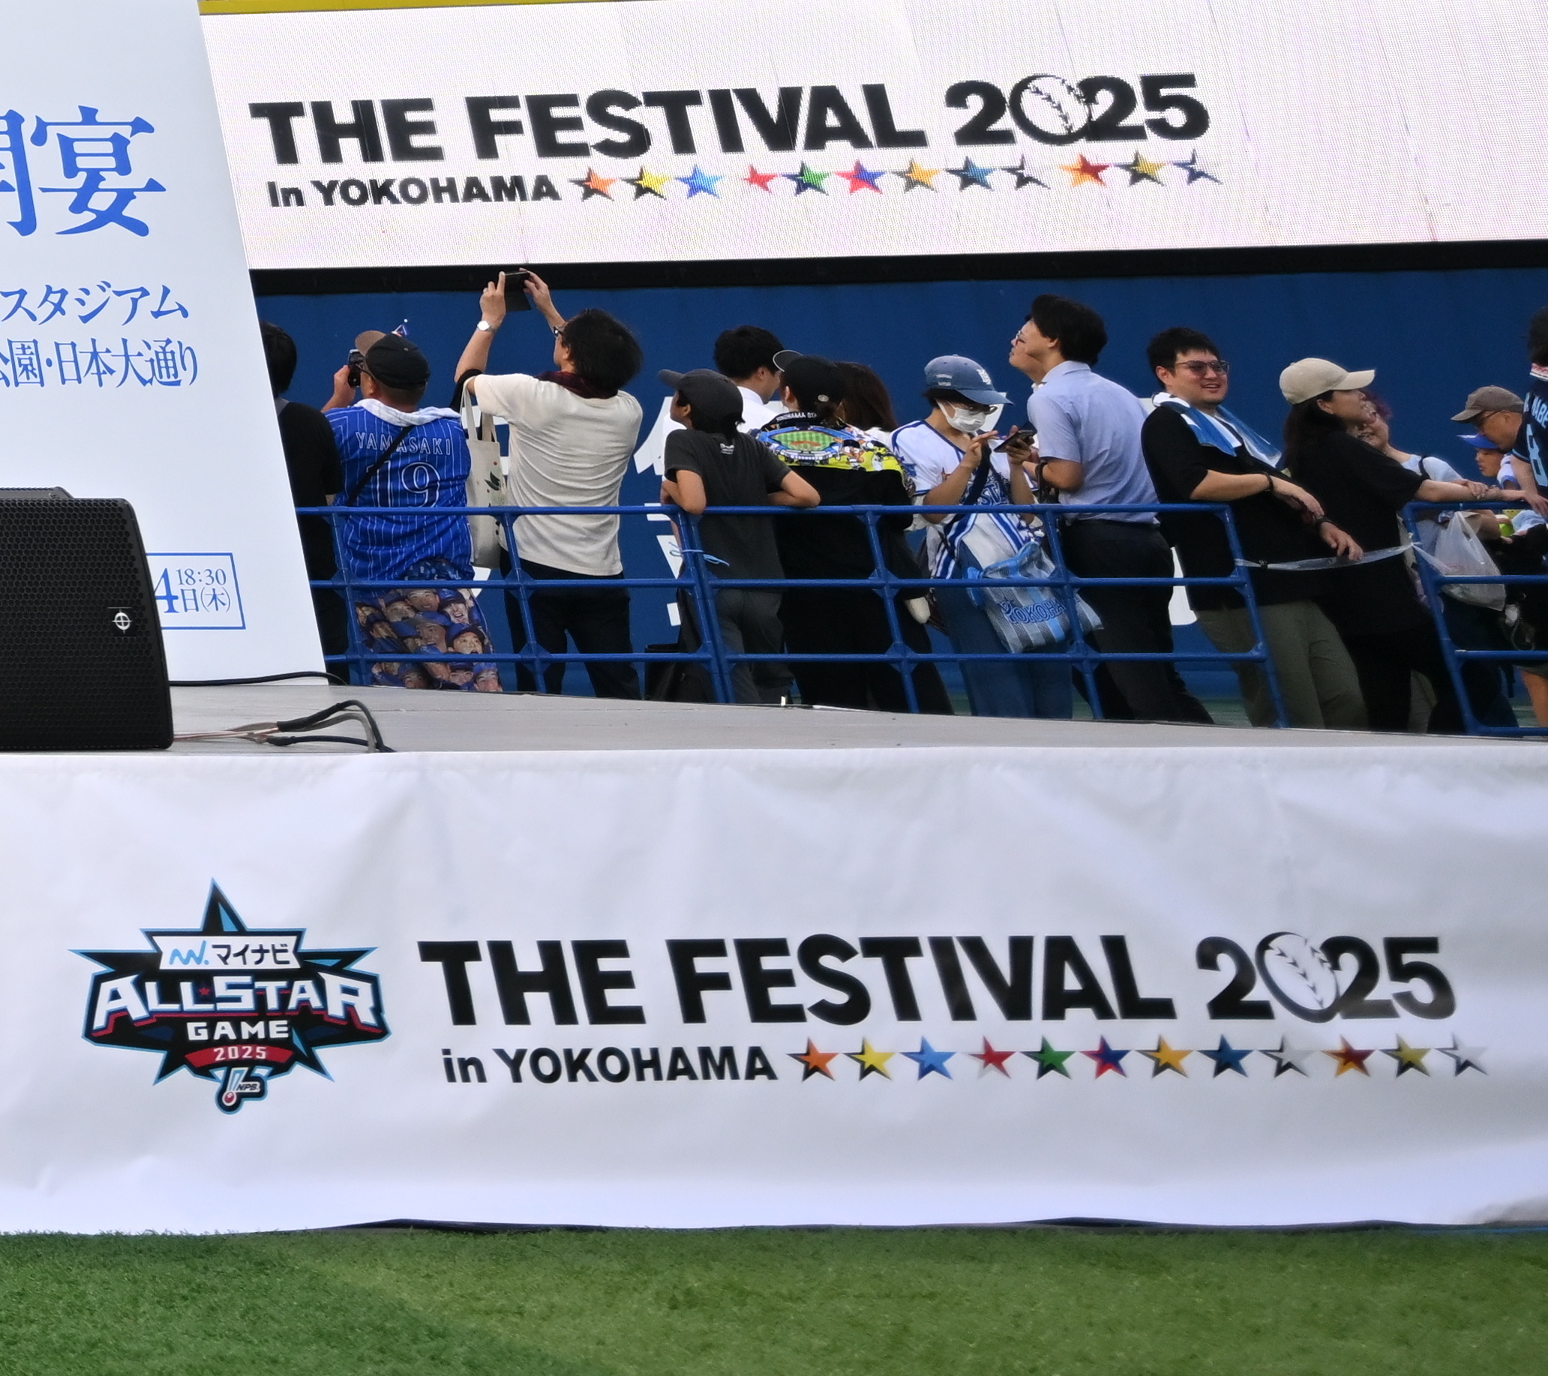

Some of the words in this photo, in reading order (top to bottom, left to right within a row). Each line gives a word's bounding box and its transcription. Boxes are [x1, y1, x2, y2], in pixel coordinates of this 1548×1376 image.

[248, 98, 445, 165] THE
[464, 86, 928, 162] FESTIVAL
[943, 72, 1211, 145] 2025
[310, 174, 562, 208] YOKOHAMA
[355, 431, 452, 456] YAMASAKI
[366, 460, 441, 508] 19
[176, 567, 228, 587] 18:30
[212, 943, 291, 967] マイナビ
[417, 938, 646, 1026] THE
[665, 933, 1178, 1026] FESTIVAL
[1194, 931, 1457, 1024] 2025
[187, 1019, 290, 1042] GAME
[213, 1045, 267, 1063] 2025
[441, 1048, 486, 1084] in
[503, 1047, 778, 1084] YOKOHAMA
